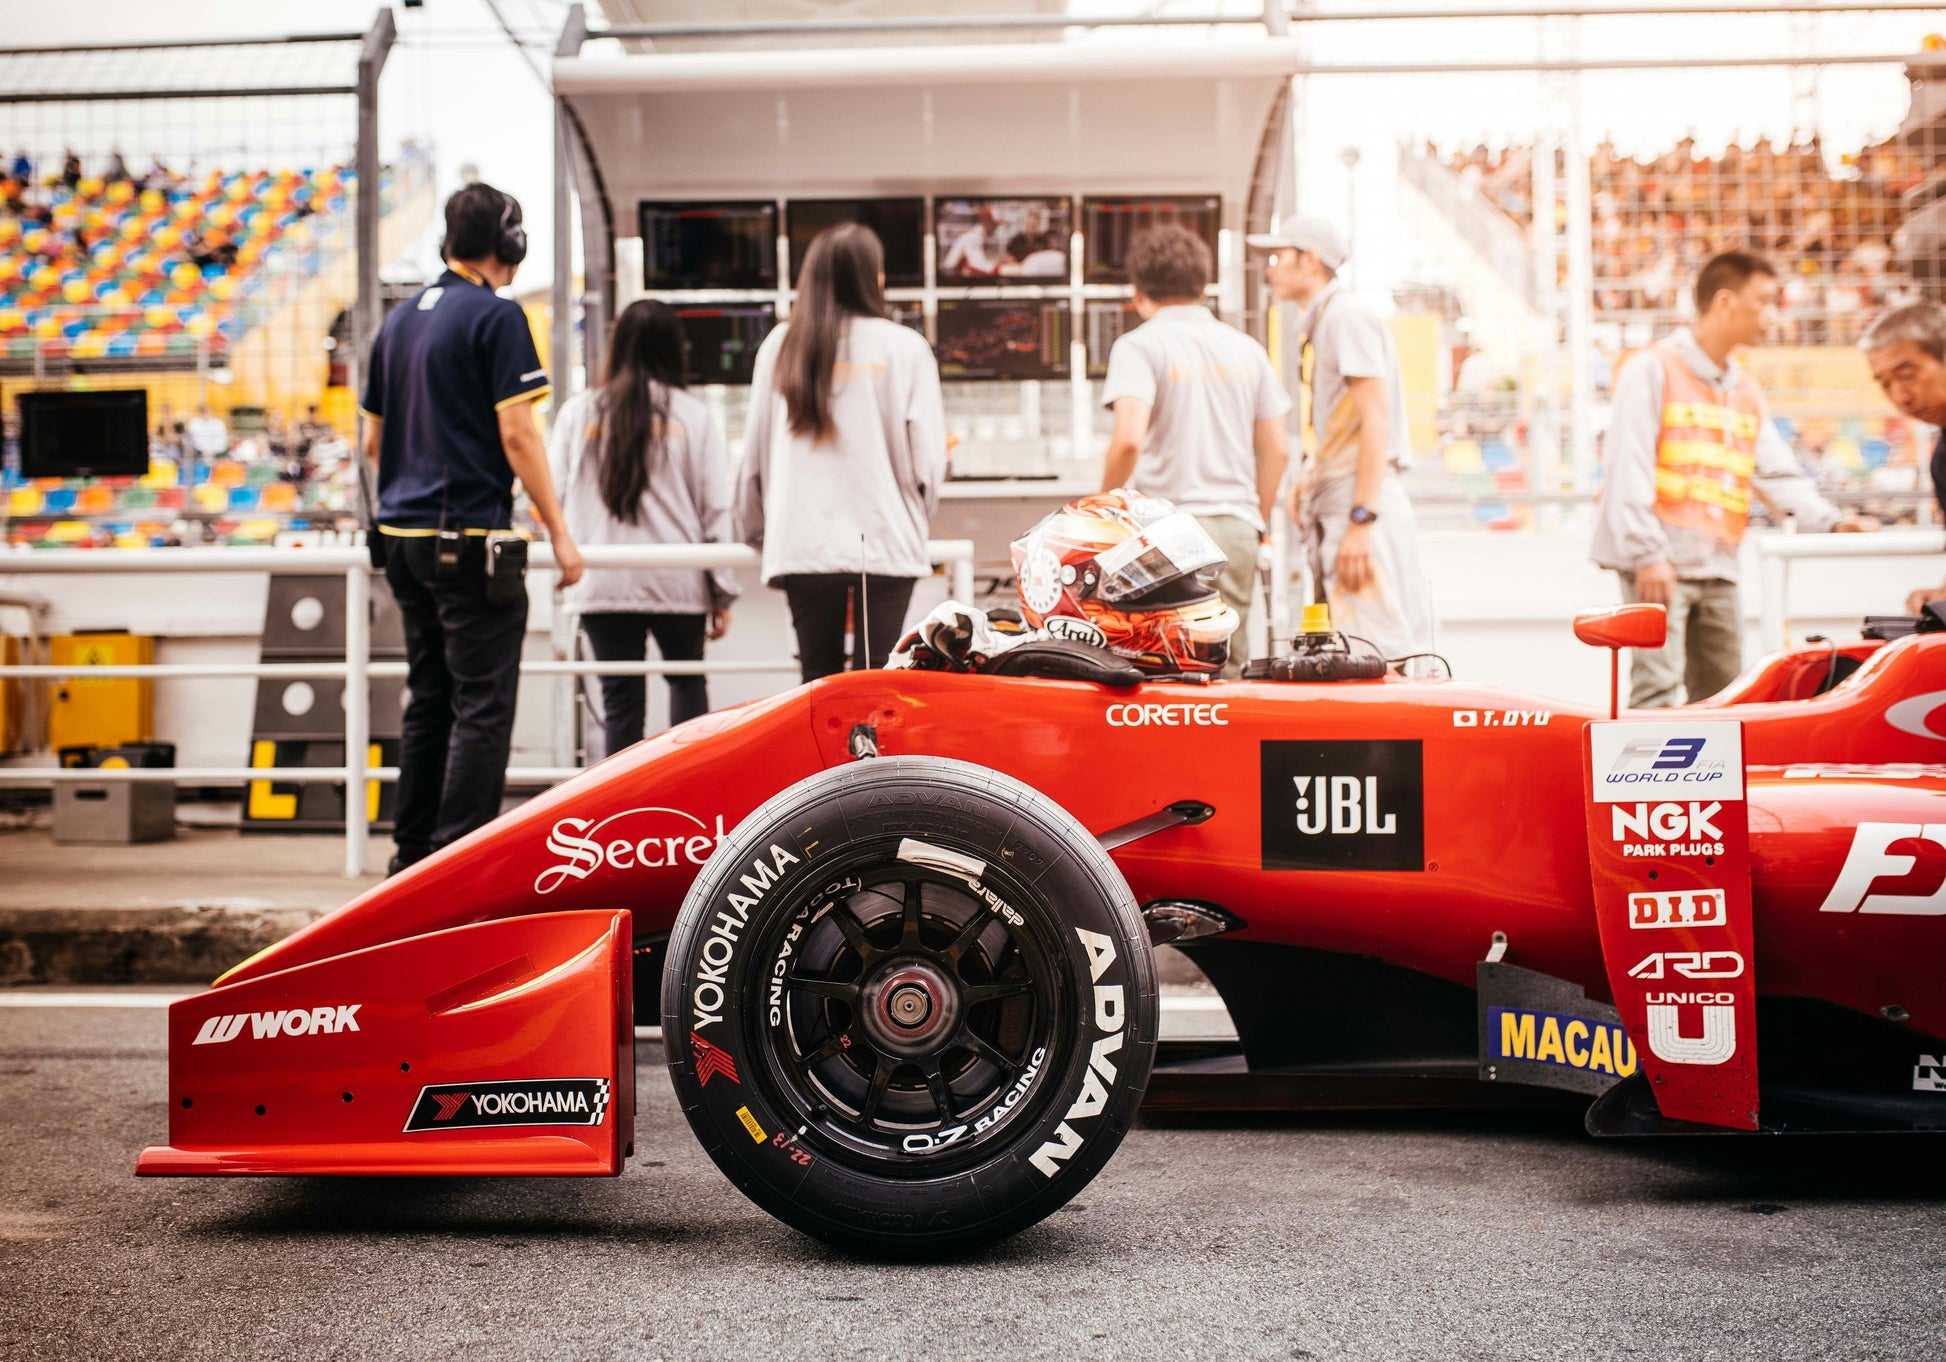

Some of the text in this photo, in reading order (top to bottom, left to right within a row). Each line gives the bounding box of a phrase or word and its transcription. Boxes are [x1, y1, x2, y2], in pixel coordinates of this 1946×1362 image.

[1052, 621, 1097, 643] Arai
[1105, 703, 1229, 727] CORETEC
[1611, 738, 1707, 770] F3
[1605, 772, 1723, 783] WORLD CUP
[1293, 775, 1397, 835] JBL
[1611, 801, 1724, 841] NGK
[1623, 842, 1725, 857] PARK PLUGS
[968, 880, 1025, 927] dallara
[1633, 894, 1718, 924] D.I.D
[693, 844, 800, 1030] YOKOHAMA
[769, 923, 805, 1028] RACING
[1627, 950, 1745, 979] ARD
[1645, 992, 1735, 1004] UNICO
[251, 1004, 362, 1040] WORK
[1028, 926, 1125, 1178] ADVAN
[1501, 1012, 1637, 1078] MACAU
[470, 1091, 589, 1116] YOKOHAMA
[973, 1047, 1046, 1135] RACING
